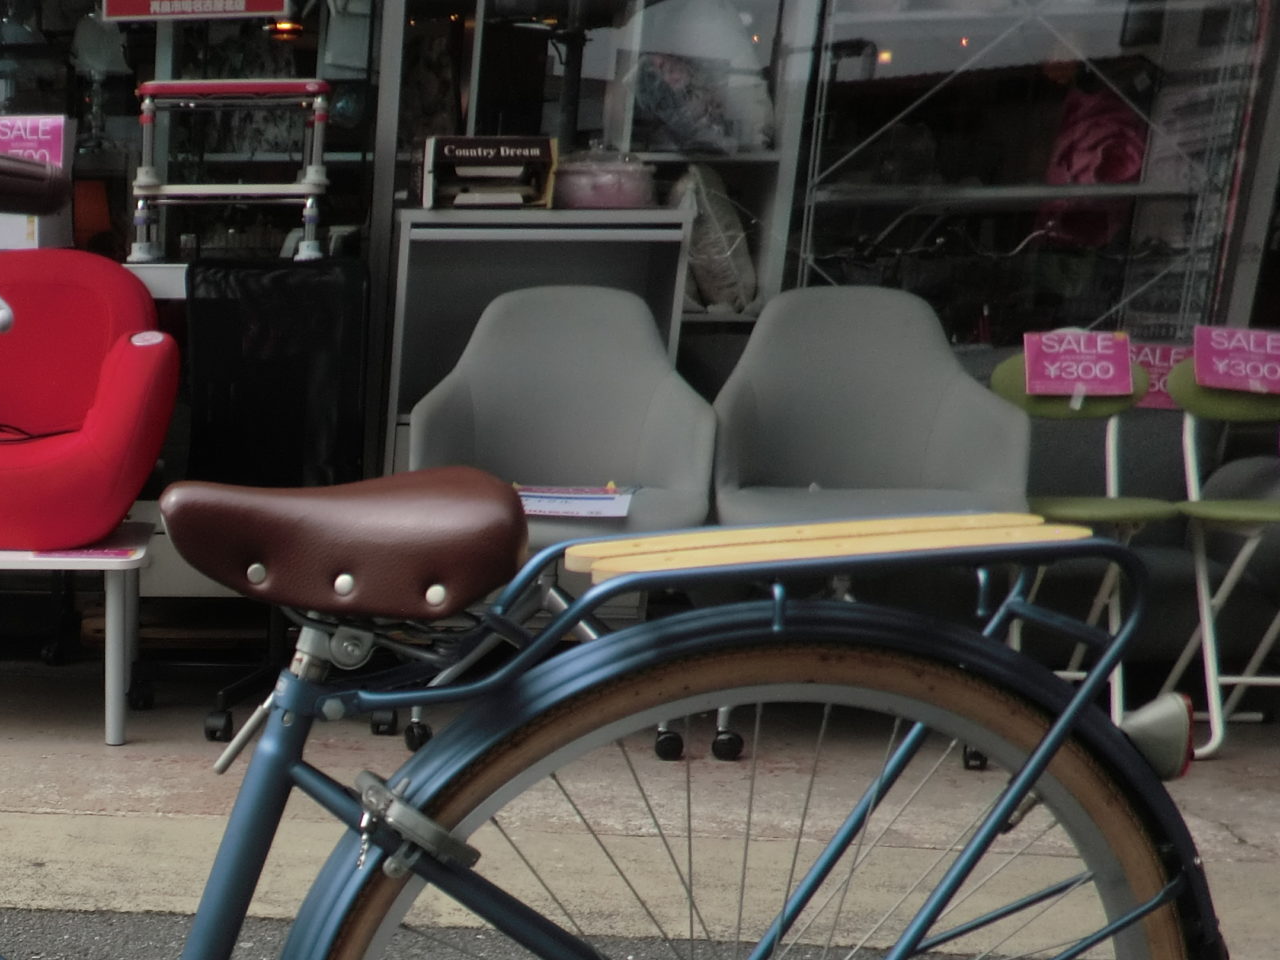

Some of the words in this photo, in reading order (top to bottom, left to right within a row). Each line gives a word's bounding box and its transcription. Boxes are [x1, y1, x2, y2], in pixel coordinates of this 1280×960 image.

[444, 144, 496, 159] Country
[500, 145, 541, 157] Dream
[1041, 333, 1115, 354] SALE
[1210, 330, 1280, 355] SALE
[1043, 360, 1115, 379] ¥300
[1212, 356, 1280, 380] ¥300
